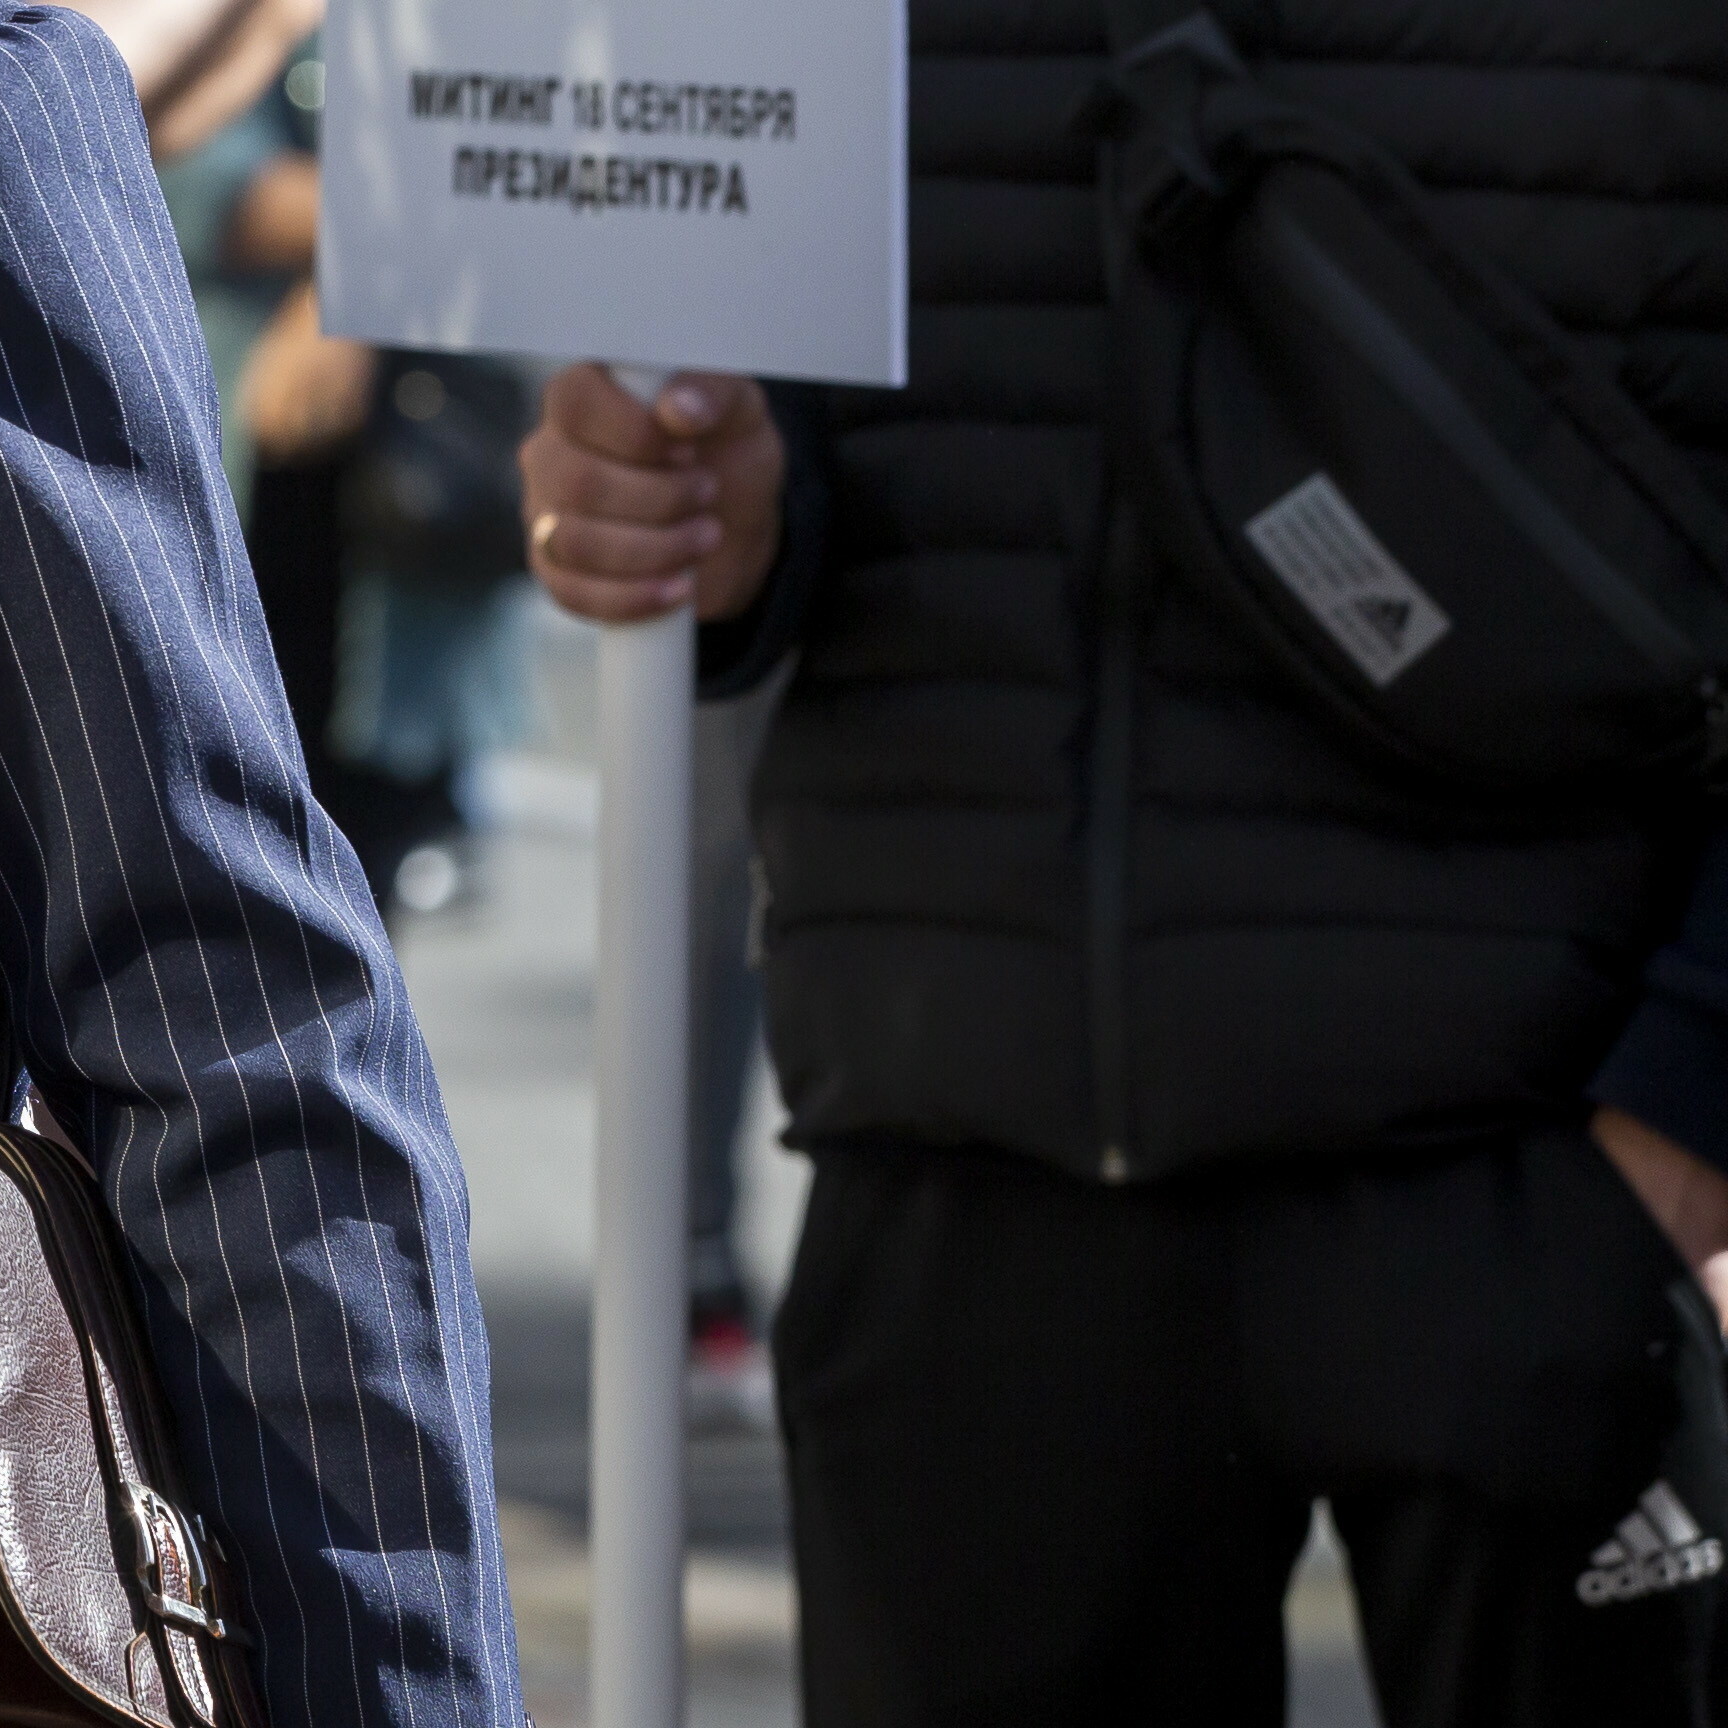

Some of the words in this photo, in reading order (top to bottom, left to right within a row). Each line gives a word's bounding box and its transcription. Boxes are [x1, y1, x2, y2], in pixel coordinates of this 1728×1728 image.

[408, 69, 558, 126] МИТИНГ
[612, 78, 798, 141] СЕНТЯБРЯ
[451, 143, 750, 214] ПРЕЗИДЕНТУРА
[1575, 1537, 1724, 1608] adidas
